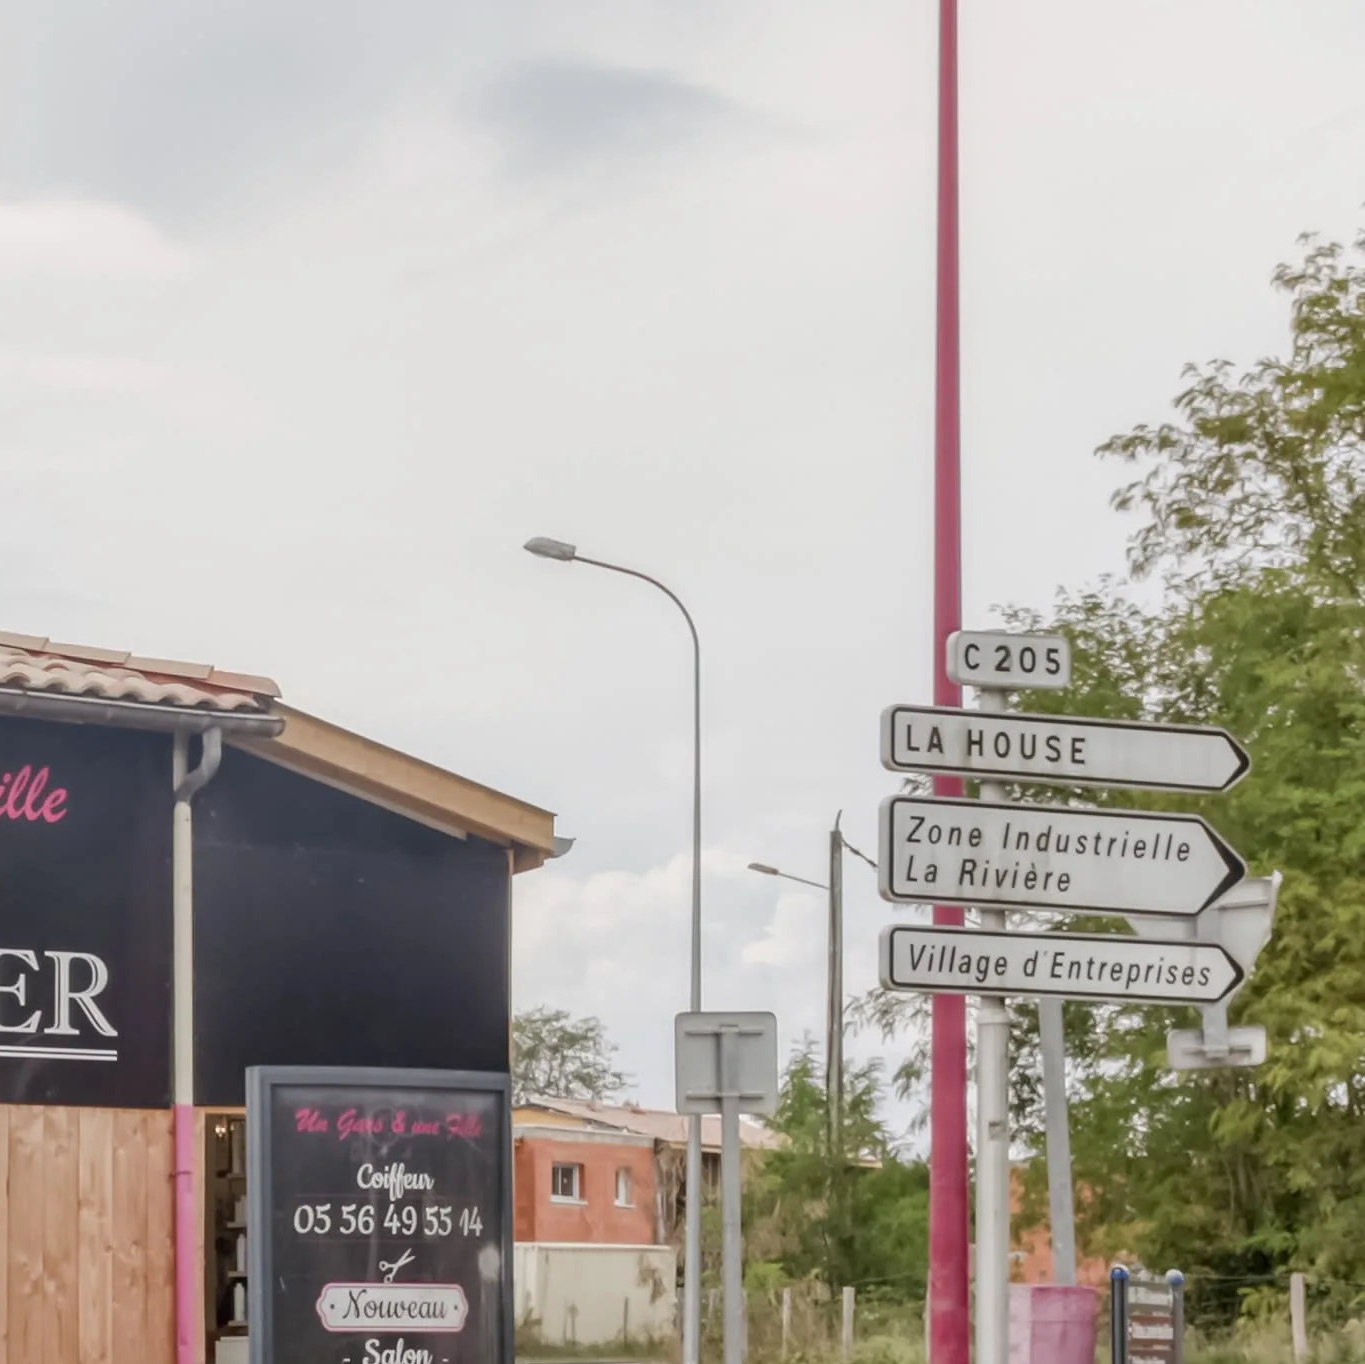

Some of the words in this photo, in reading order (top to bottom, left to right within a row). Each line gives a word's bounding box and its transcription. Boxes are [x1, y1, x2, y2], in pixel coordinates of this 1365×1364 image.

[964, 644, 981, 670] C
[994, 645, 1061, 675] 205
[906, 724, 944, 753] LA
[968, 729, 1086, 764] HOUSE
[906, 816, 983, 848] Zone
[1003, 822, 1191, 861] Industrielle
[906, 855, 938, 883] La
[959, 859, 1071, 892] Rivière
[909, 943, 1008, 982] Village
[1023, 950, 1211, 990] d'Entreprises
[295, 1108, 328, 1132] Un
[357, 1162, 435, 1201] Coiffeur
[294, 1203, 331, 1235] 05
[340, 1203, 375, 1235] 56
[383, 1203, 418, 1235] 49
[424, 1206, 452, 1236] 55
[459, 1206, 484, 1236] 14
[342, 1289, 448, 1320] Nouveau
